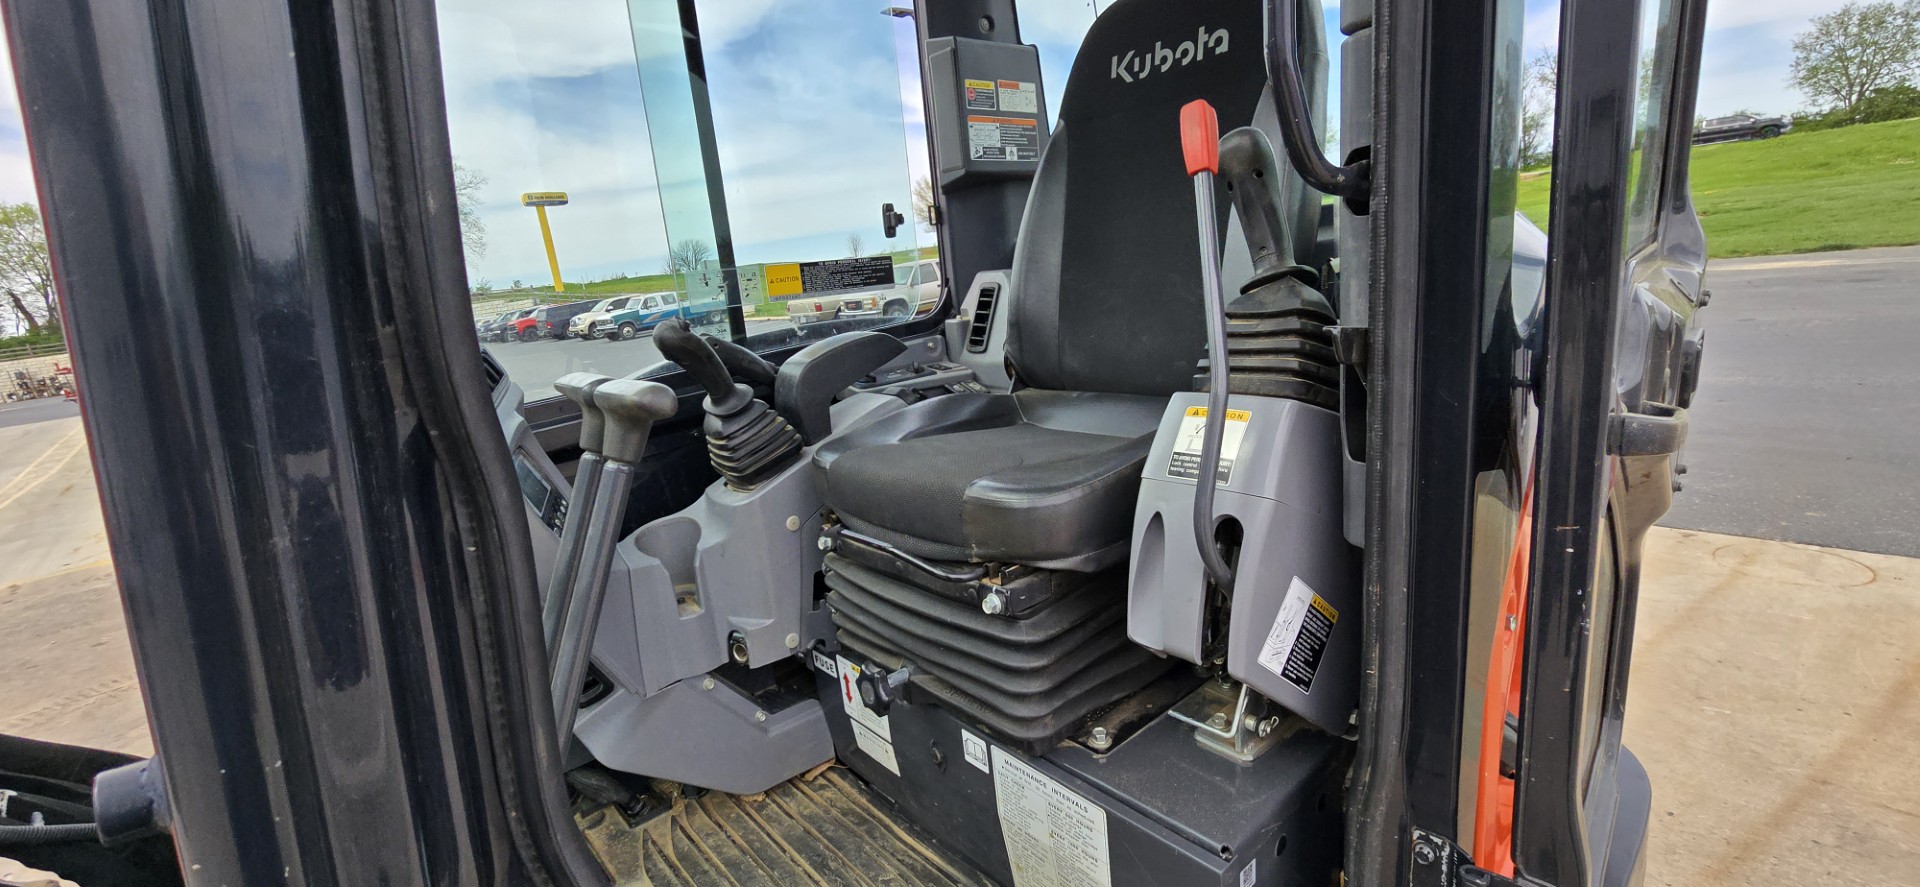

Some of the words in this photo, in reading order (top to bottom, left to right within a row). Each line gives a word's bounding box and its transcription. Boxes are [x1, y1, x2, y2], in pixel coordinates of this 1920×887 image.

[1110, 25, 1230, 83] Kubota
[1202, 410, 1243, 420] CION
[1316, 601, 1336, 620] CAUTION
[814, 654, 835, 674] FUSE
[1004, 758, 1048, 789] MAINTENANCE
[1051, 787, 1089, 814] INTERVALS
